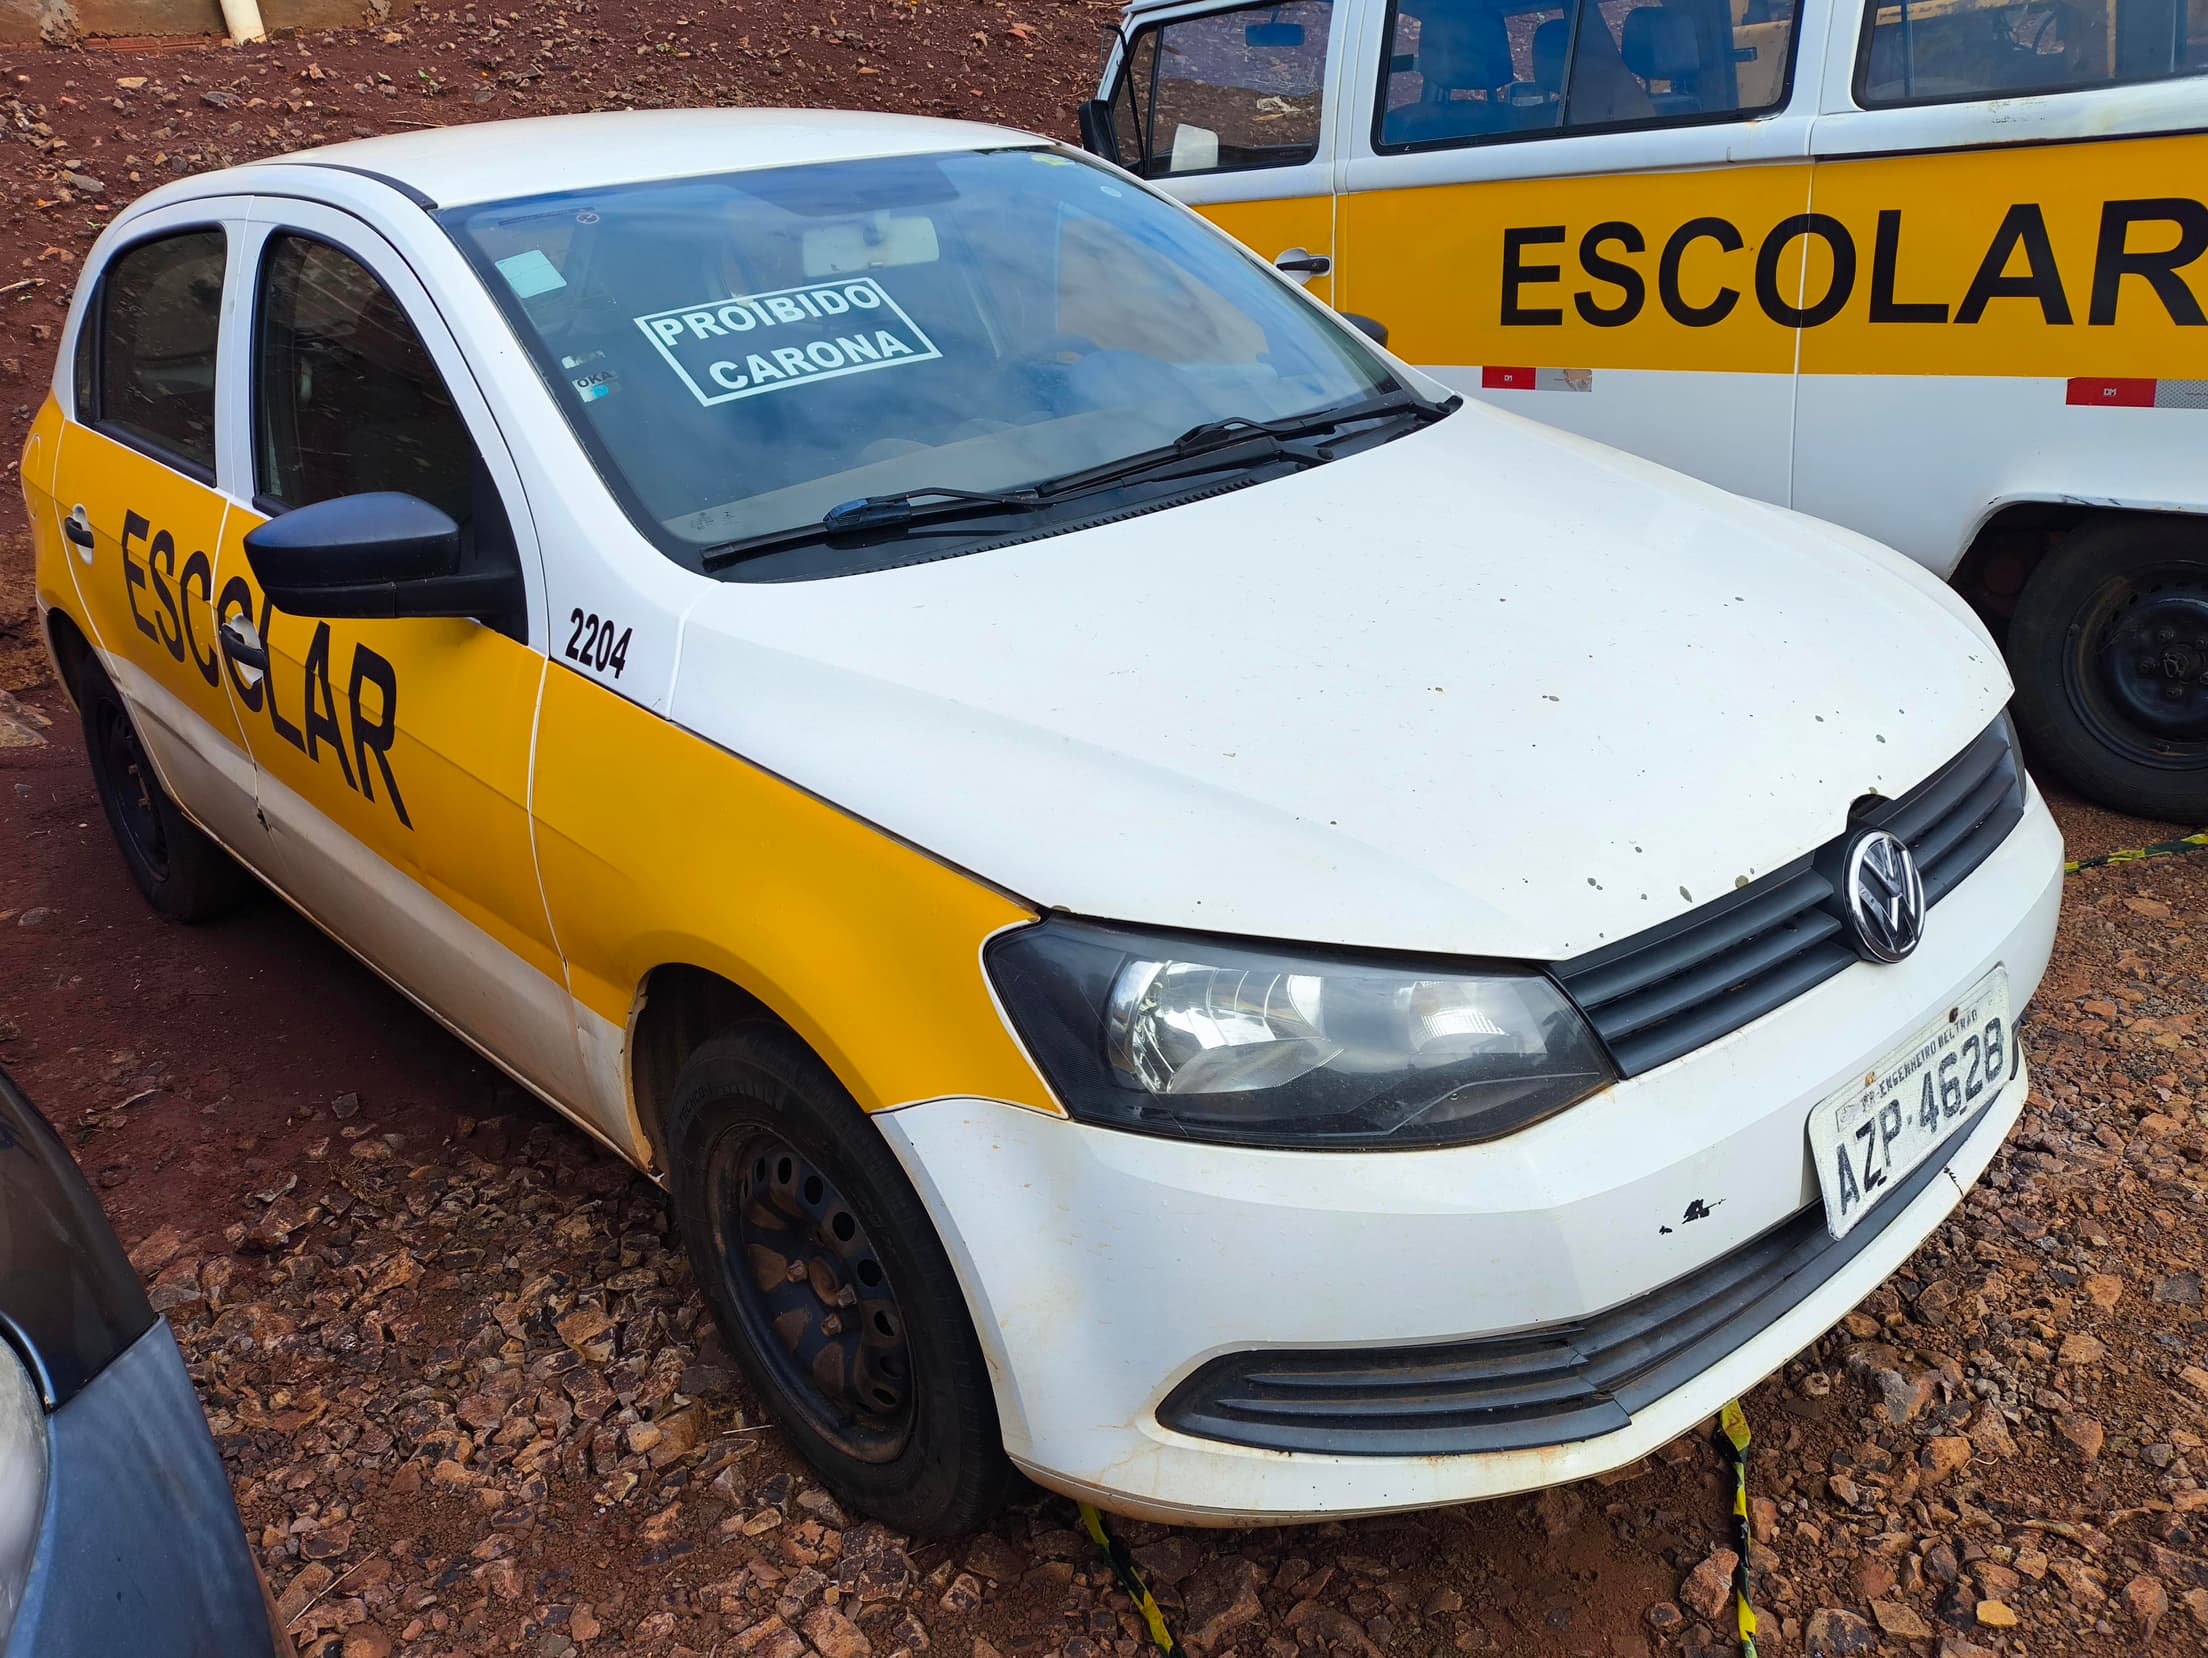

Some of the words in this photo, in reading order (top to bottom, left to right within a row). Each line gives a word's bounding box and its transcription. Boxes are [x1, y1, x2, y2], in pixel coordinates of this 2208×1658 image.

[1499, 198, 2208, 328] ESCOLAR
[650, 284, 882, 347] PROIBIDO
[708, 329, 913, 391] CARONA
[565, 607, 633, 679] 2204
